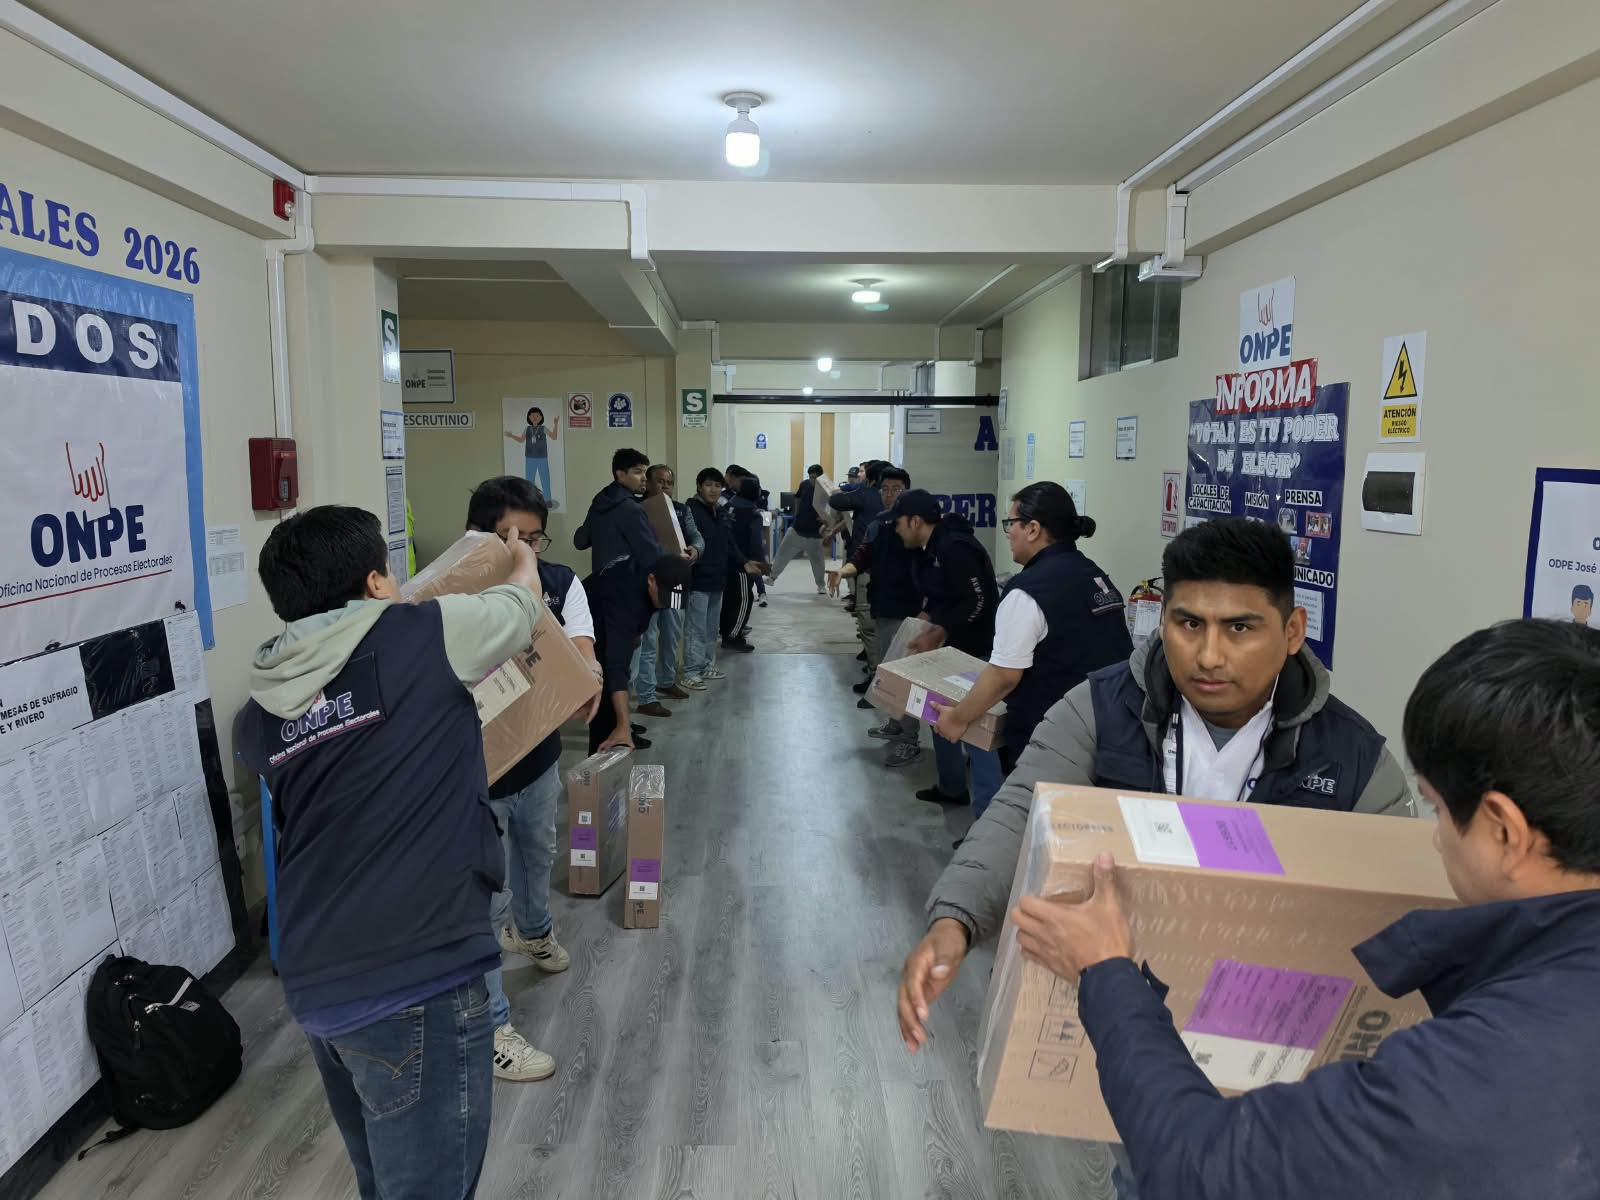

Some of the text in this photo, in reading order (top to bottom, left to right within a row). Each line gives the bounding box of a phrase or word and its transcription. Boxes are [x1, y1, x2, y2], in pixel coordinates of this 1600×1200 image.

[124, 226, 200, 285] 2026
[1240, 323, 1292, 365] ONPE
[1215, 363, 1312, 411] INFORMA
[686, 392, 704, 412] S
[403, 414, 469, 426] ESCRUTINIO
[1238, 419, 1257, 445] ES
[1259, 417, 1281, 443] TU
[1282, 413, 1340, 444] PODER
[1216, 449, 1235, 473] DE
[1192, 484, 1229, 498] LOCALES DE
[1245, 491, 1269, 508] MISIÓN
[1285, 490, 1321, 505] PRENSA
[31, 504, 147, 568] ONPE
[0, 554, 173, 598] Oficina Nacional de Procesos Electorales
[1548, 558, 1597, 573] ODPE José
[0, 703, 28, 721] MESAS
[29, 698, 41, 710] DE
[41, 685, 79, 706] SUFRAGIO
[281, 691, 355, 742] ONPE
[15, 710, 45, 729] RIVERO
